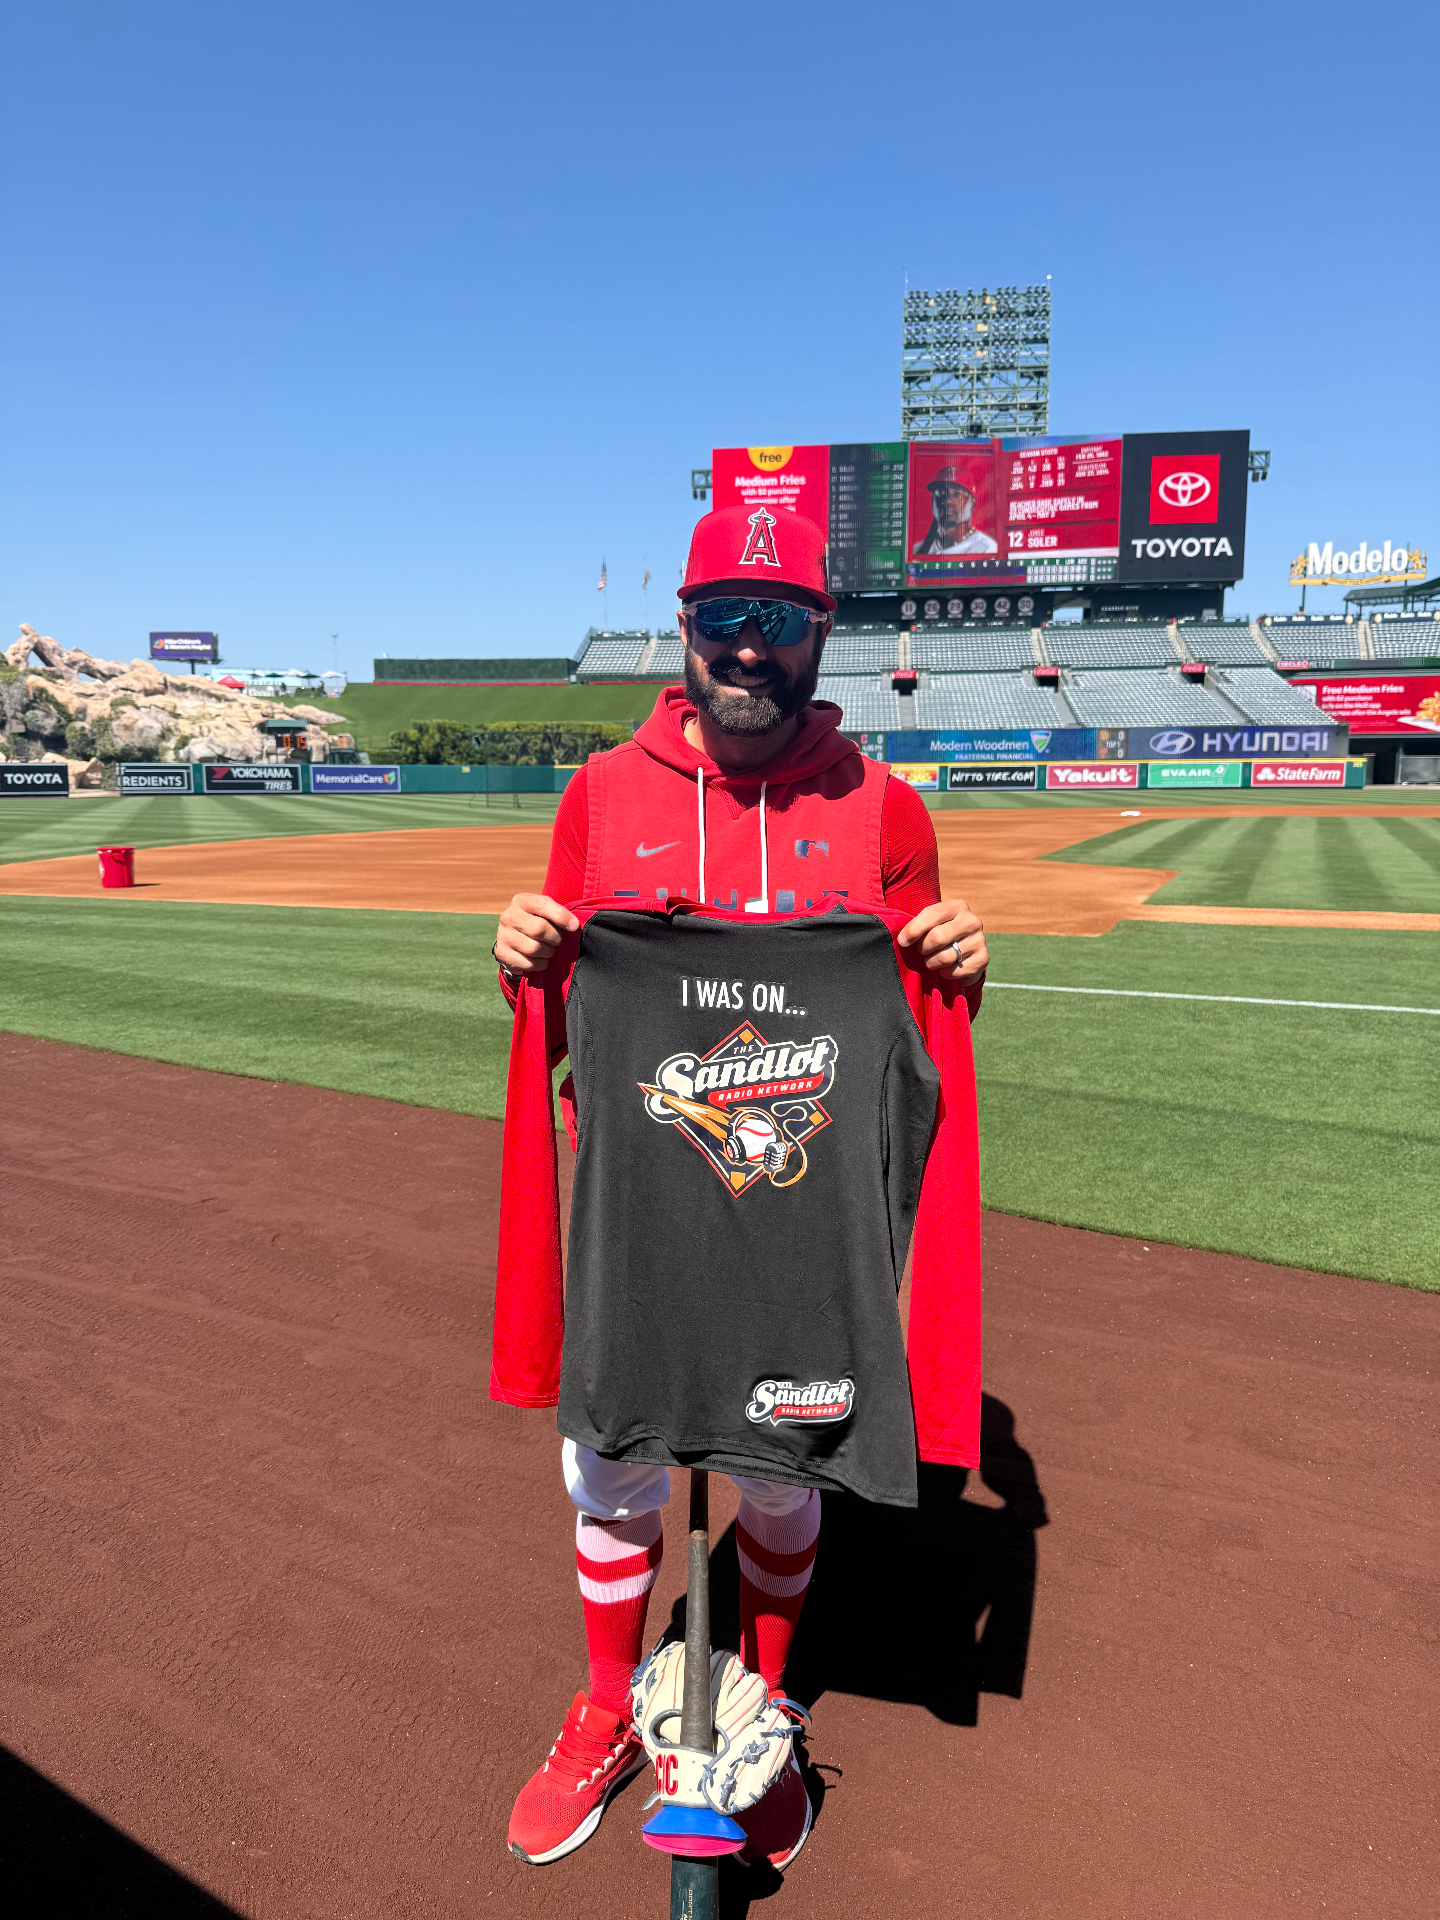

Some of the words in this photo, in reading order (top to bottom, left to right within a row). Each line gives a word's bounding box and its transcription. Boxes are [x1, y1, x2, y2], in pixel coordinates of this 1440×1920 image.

[759, 452, 782, 463] free
[735, 475, 778, 488] Medium
[780, 474, 806, 486] Fries
[768, 487, 800, 497] purchase
[739, 508, 781, 567] A
[1008, 531, 1023, 547] 12
[1028, 536, 1057, 548] SOLER
[1132, 537, 1233, 559] TOYOTA
[1307, 540, 1408, 576] Modelo
[905, 604, 913, 613] 11
[973, 601, 984, 611] 30
[996, 600, 1007, 610] 42
[1019, 600, 1032, 609] 50
[1322, 686, 1342, 694] Free
[1343, 684, 1380, 694] Medium
[1381, 683, 1405, 693] Fries
[877, 734, 884, 744] 0
[1118, 730, 1124, 741] 0
[930, 740, 972, 751] Modern
[974, 739, 1029, 751] Woodmen
[1203, 731, 1328, 752] HYUNDAI
[877, 752, 883, 761] 0
[955, 753, 995, 761] FRATERNAL
[997, 752, 1034, 760] FINANCIAL
[1118, 748, 1124, 758] 0
[4, 773, 63, 785] TOYOTA
[231, 768, 291, 779] YOKOHAMA
[316, 773, 383, 784] MemorialCare
[952, 771, 982, 783] NITTO
[1053, 767, 1131, 784] Yakult
[264, 782, 292, 791] TIRES
[682, 979, 688, 1007] I
[696, 980, 744, 1010] WAS
[752, 983, 806, 1016] ON...
[733, 1044, 754, 1054] THE
[650, 1041, 830, 1115] Sandlot
[718, 1089, 753, 1102] RADIO
[757, 1080, 813, 1096] NETWORK
[748, 1382, 850, 1418] Sandlot
[781, 1407, 800, 1415] RADIO
[801, 1406, 839, 1415] NETWORK
